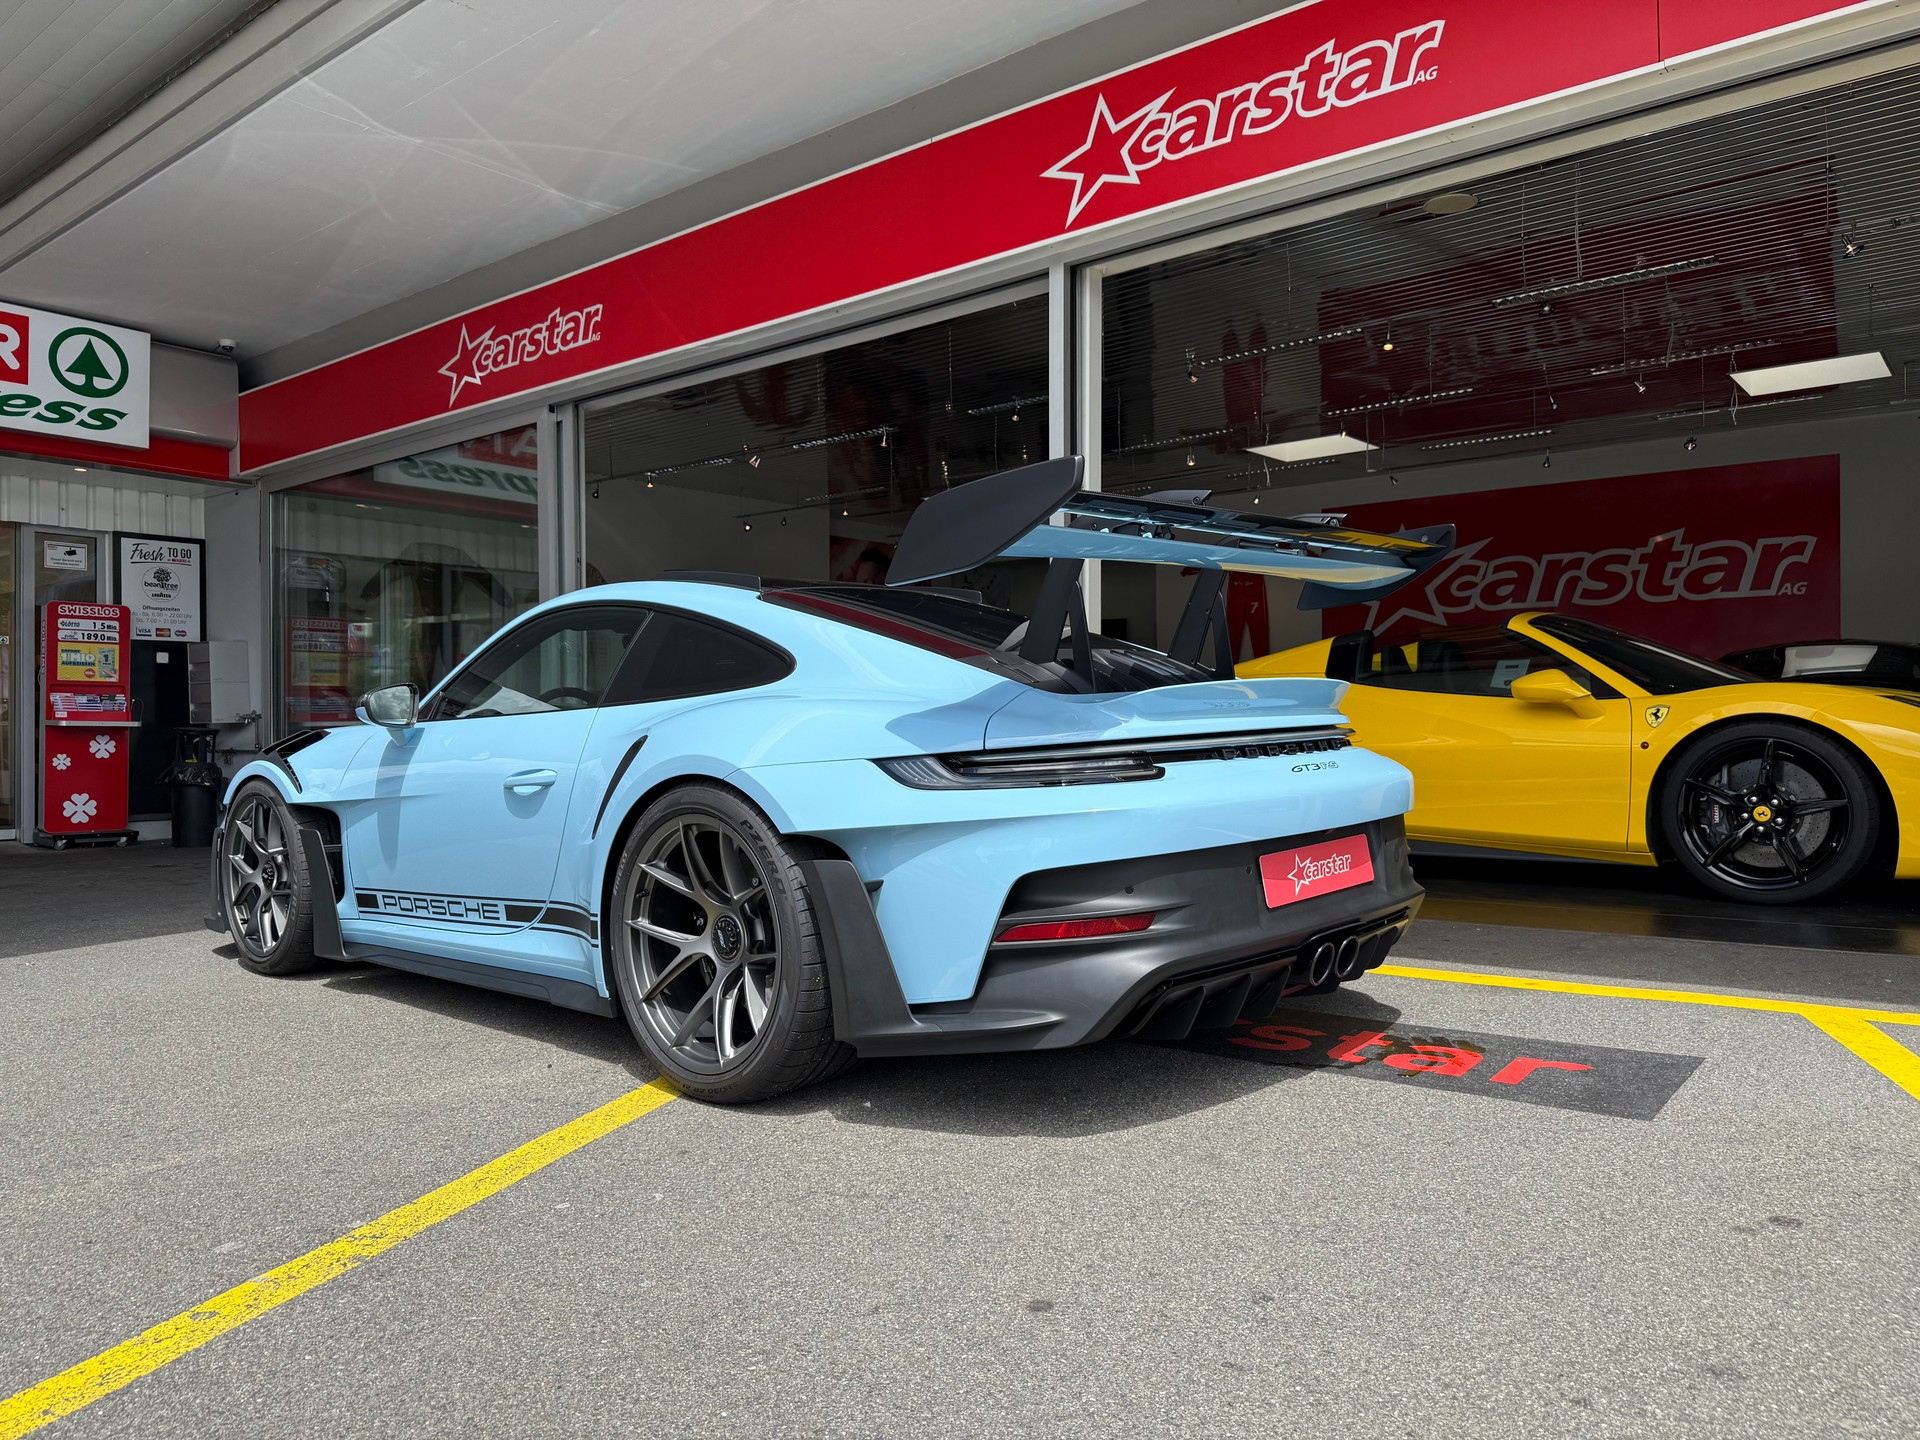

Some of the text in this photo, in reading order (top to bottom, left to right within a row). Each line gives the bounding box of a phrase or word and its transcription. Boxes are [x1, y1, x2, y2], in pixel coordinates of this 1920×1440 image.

[1121, 19, 1446, 172] carstar AG
[475, 304, 603, 376] carstar AG
[130, 543, 192, 562] Fresh TO GO
[1427, 528, 1816, 613] carstar AG
[58, 604, 120, 618] SWISSLOS
[1250, 601, 1259, 613] 7
[1304, 853, 1351, 881] carstar
[381, 894, 501, 921] PORSCHE
[1227, 1019, 1596, 1085] star
